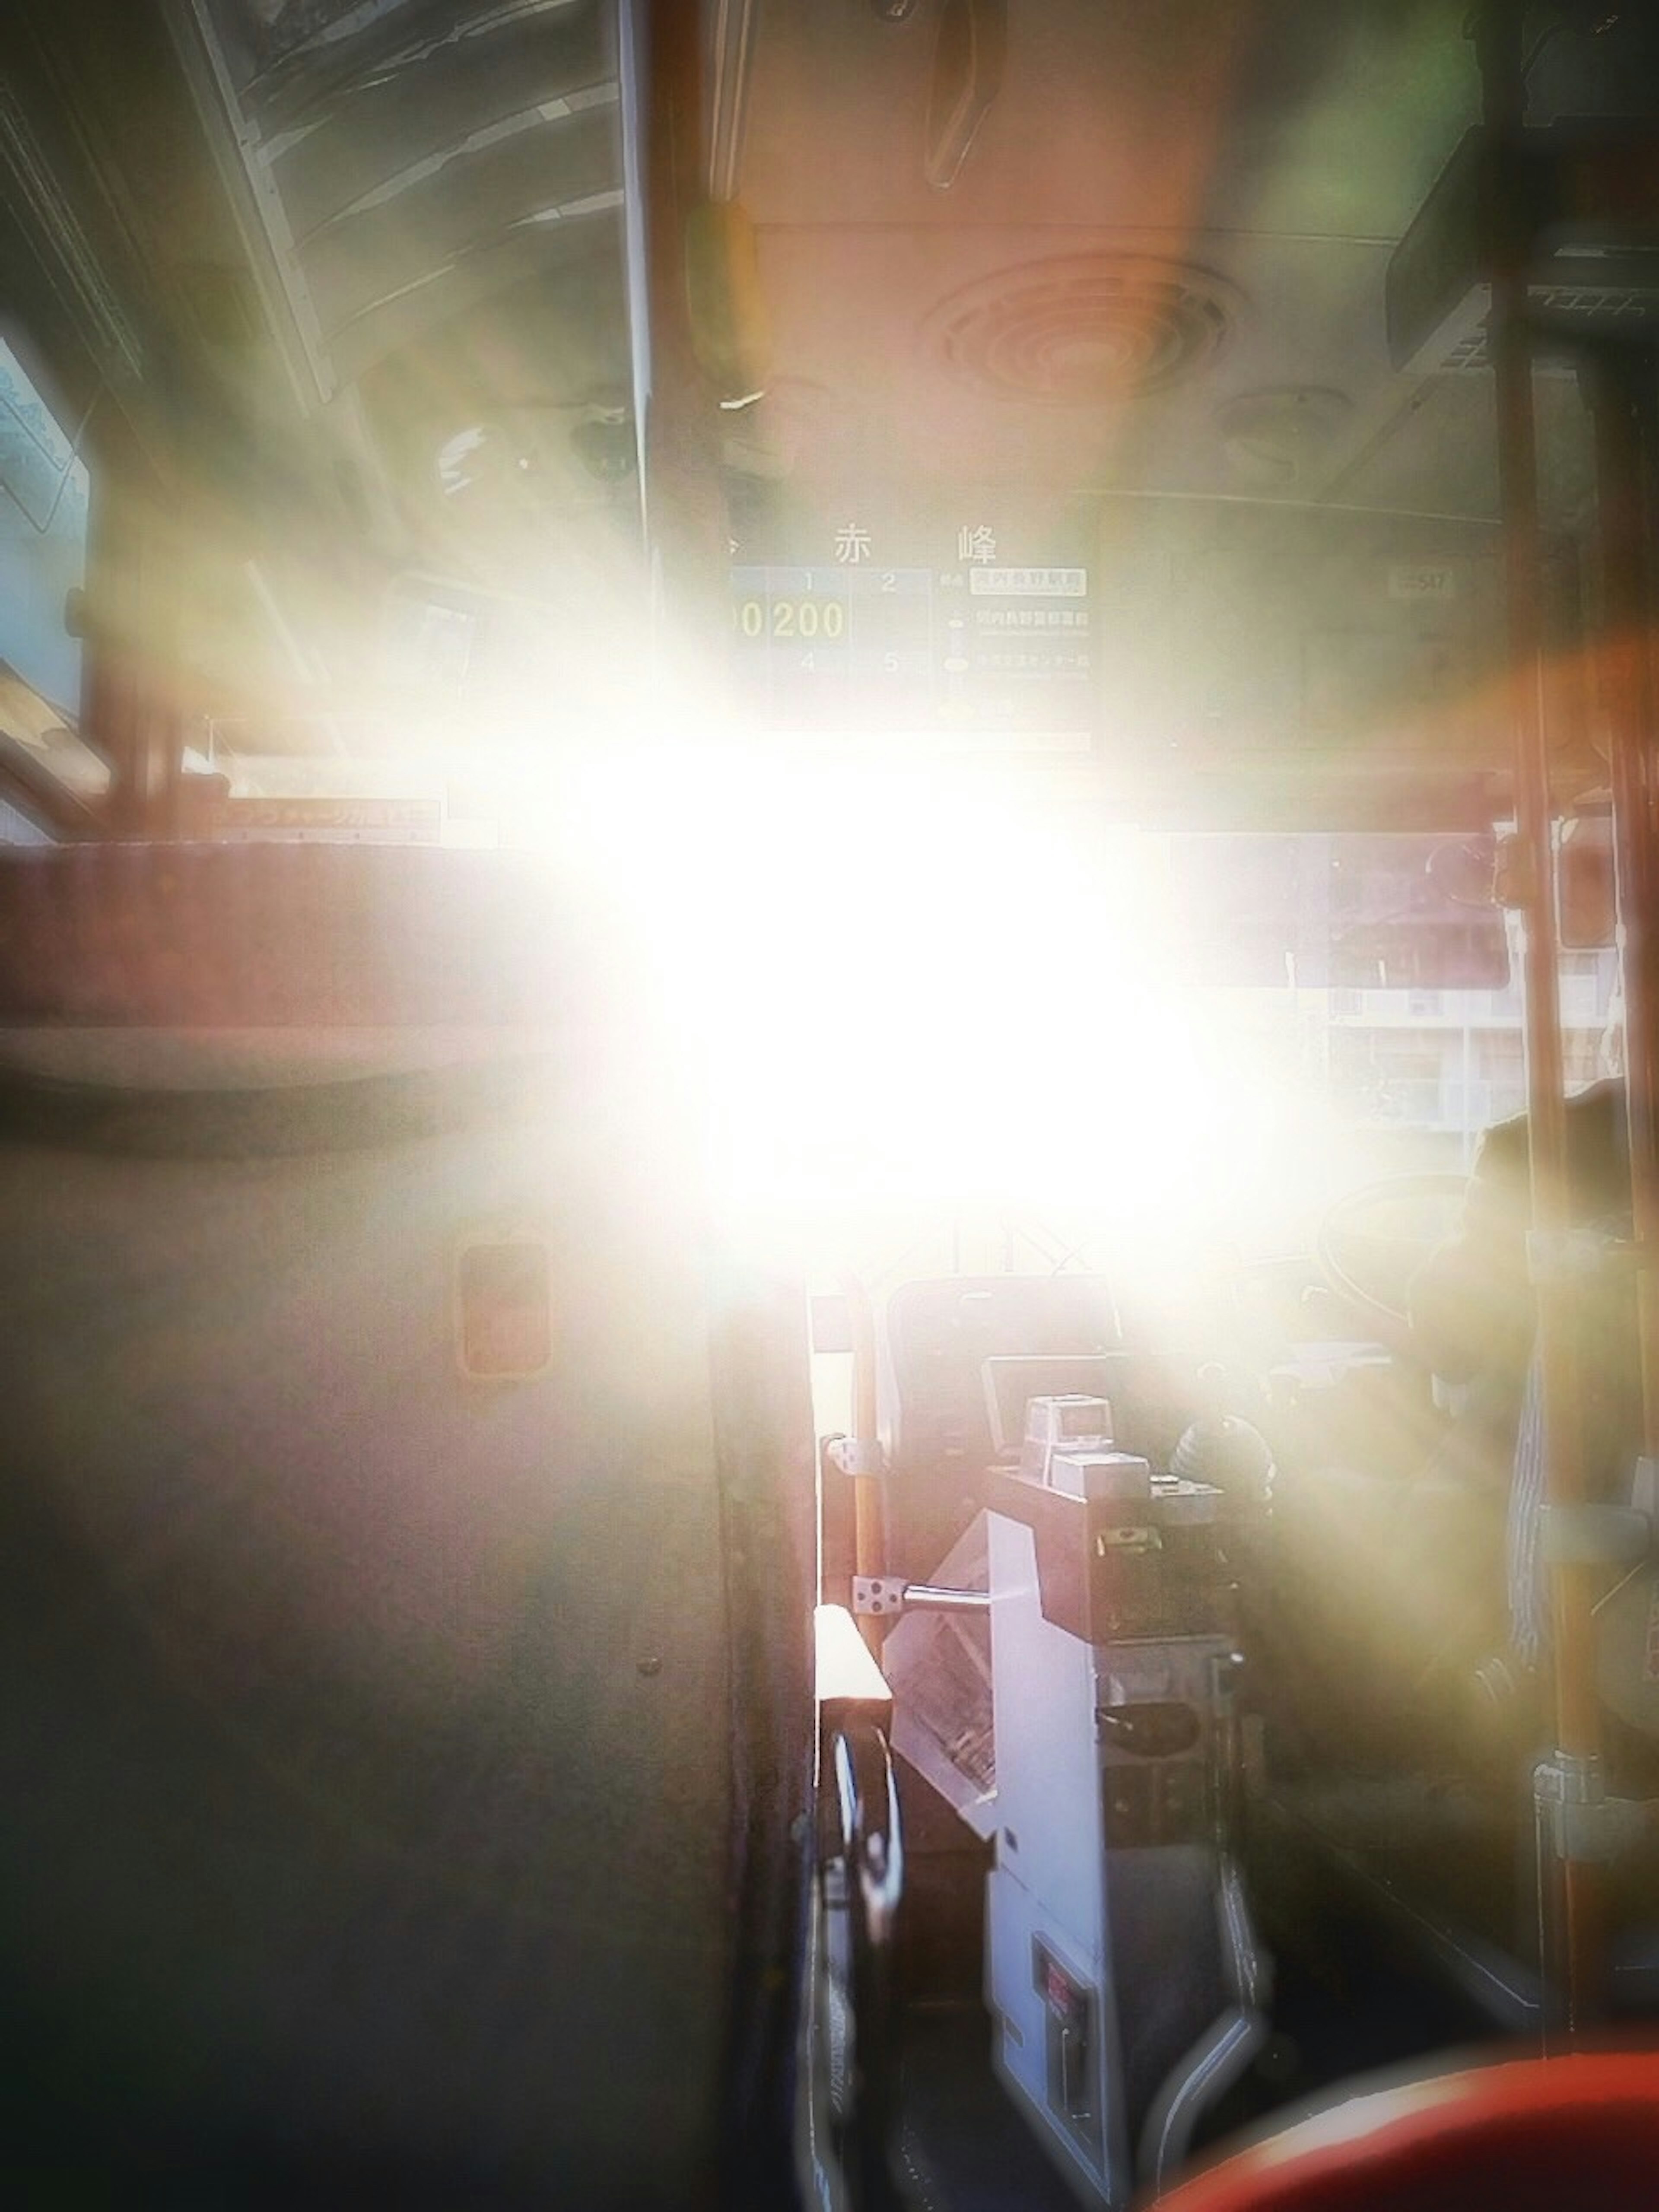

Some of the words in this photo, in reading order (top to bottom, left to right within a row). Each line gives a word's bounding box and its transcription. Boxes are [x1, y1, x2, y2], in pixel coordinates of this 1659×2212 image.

[804, 572, 813, 590] 1
[881, 571, 897, 592] 2
[773, 601, 843, 638] 200
[801, 652, 815, 672] 4
[884, 652, 899, 672] 5
